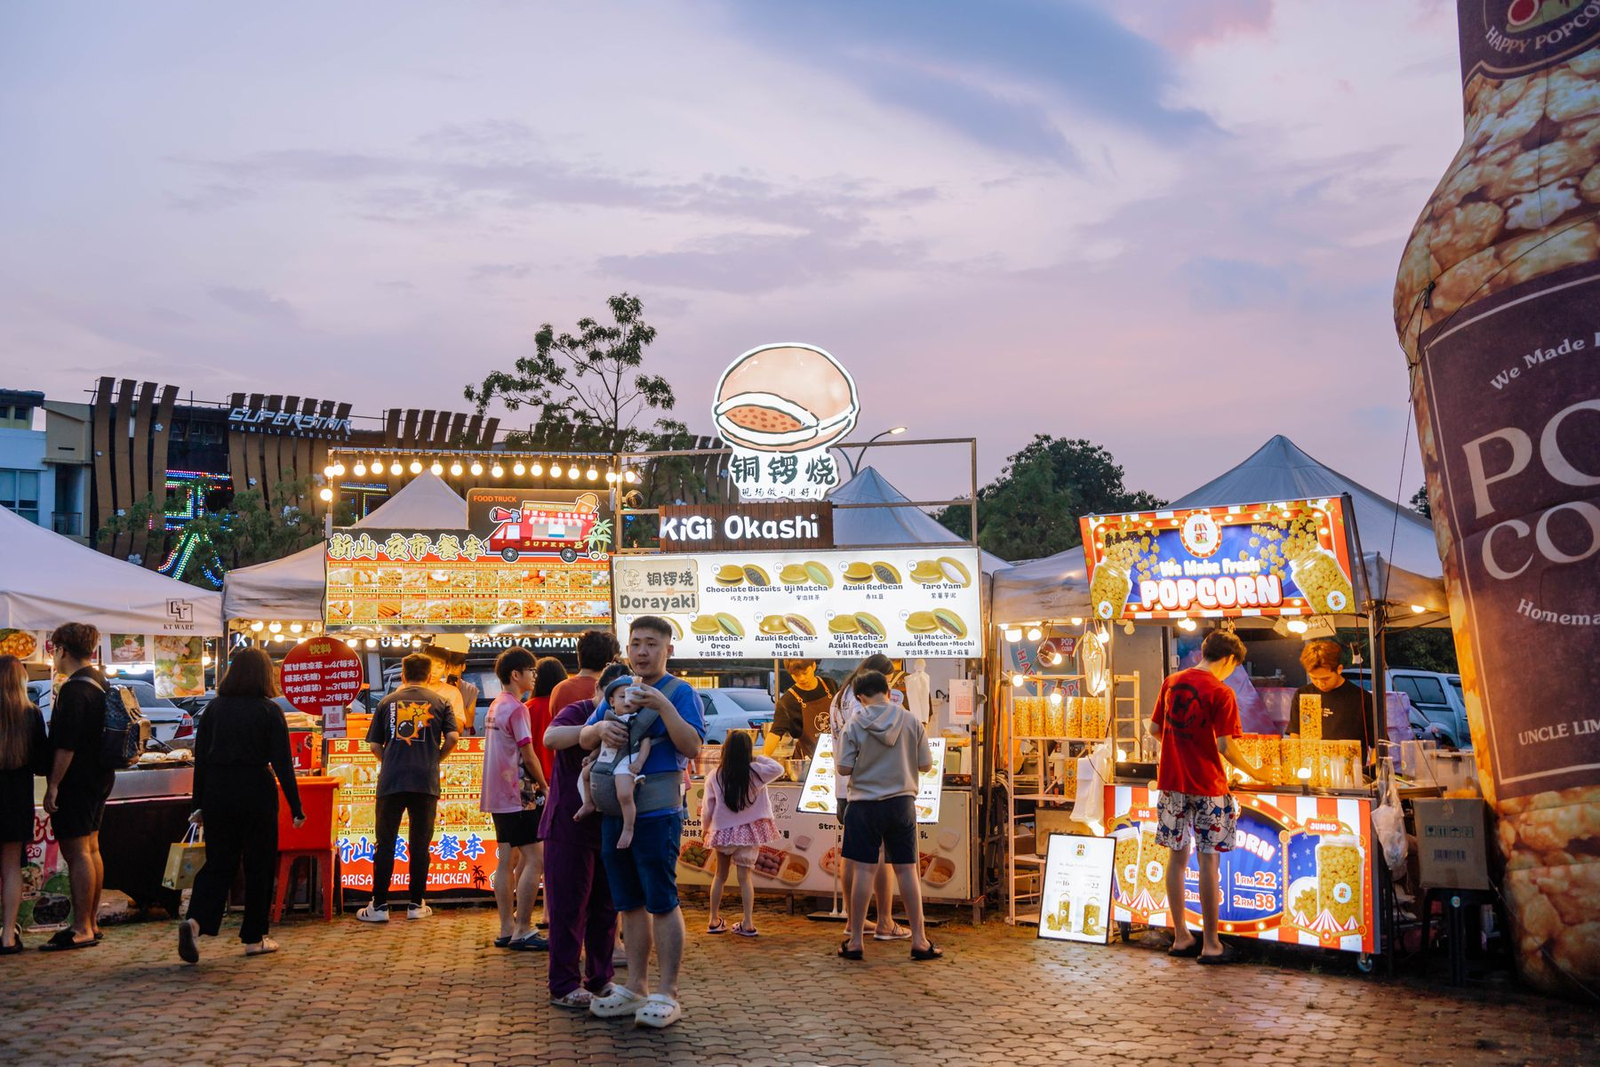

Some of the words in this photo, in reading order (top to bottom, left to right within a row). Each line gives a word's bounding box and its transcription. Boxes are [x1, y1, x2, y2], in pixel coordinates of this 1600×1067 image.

[1485, 25, 1531, 53] HAPPY
[1490, 367, 1520, 390] We
[1523, 338, 1586, 369] Made
[228, 408, 353, 435] SUPERSTAR
[231, 424, 281, 435] FAMILY
[290, 431, 350, 441] KARAOKE
[731, 454, 836, 485] 铜锣烧
[724, 513, 819, 540] Okashi
[647, 571, 694, 586] 铜锣烧
[784, 585, 796, 594] Uji
[1140, 574, 1282, 610] POPCORN
[620, 594, 696, 611] Dorayaki
[534, 637, 580, 648] JAPAN
[696, 635, 707, 643] Uji
[755, 634, 777, 642] Azuki
[833, 634, 845, 643] Uji
[913, 634, 922, 642] Uji
[1518, 723, 1569, 746] UNCLE
[1138, 810, 1150, 818] BIG
[1310, 822, 1337, 831] JUMBO
[427, 872, 470, 885] CHICKEN
